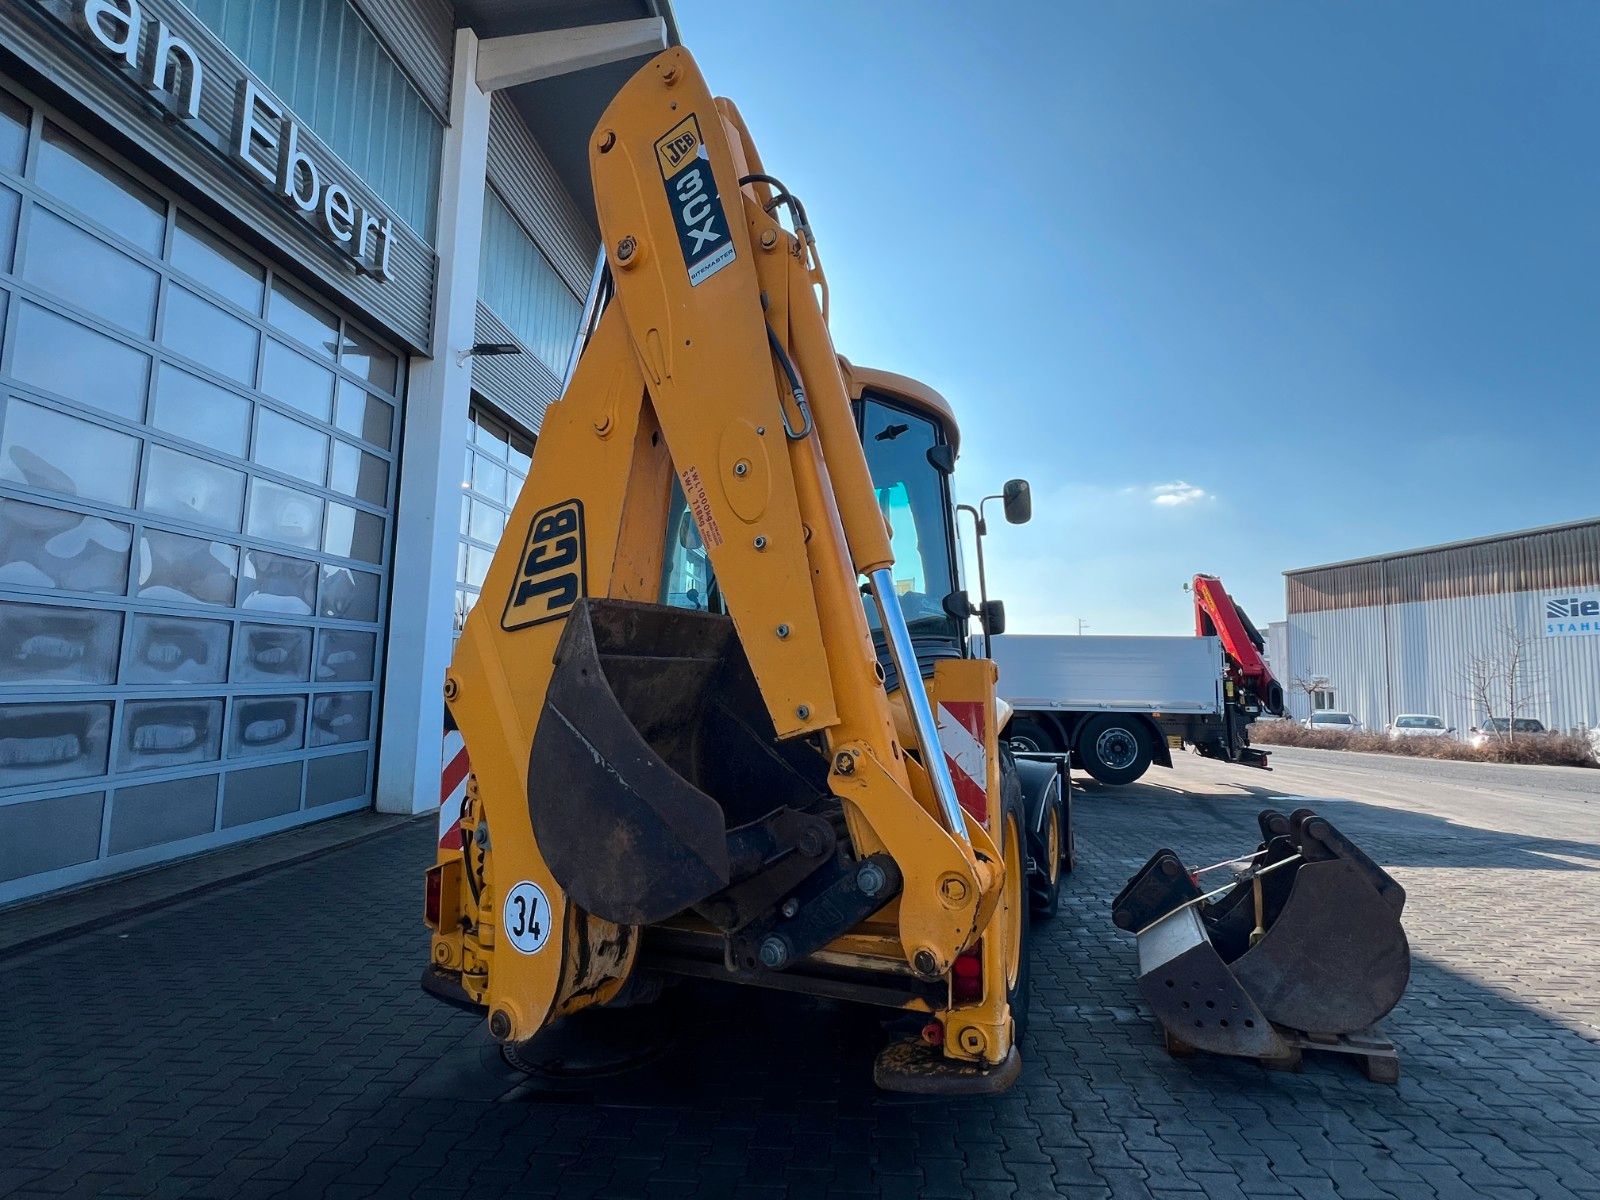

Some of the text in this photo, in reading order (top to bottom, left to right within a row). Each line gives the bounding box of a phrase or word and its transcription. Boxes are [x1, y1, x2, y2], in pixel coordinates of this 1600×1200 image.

[667, 133, 695, 164] JCB
[239, 79, 399, 282] Ebert
[676, 168, 722, 256] 3CX
[690, 248, 734, 281] SITEMASTER
[682, 471, 694, 493] SWL
[689, 466, 701, 488] SWL
[697, 487, 713, 522] 1000kg
[513, 508, 578, 611] JCB
[512, 895, 541, 941] 34
